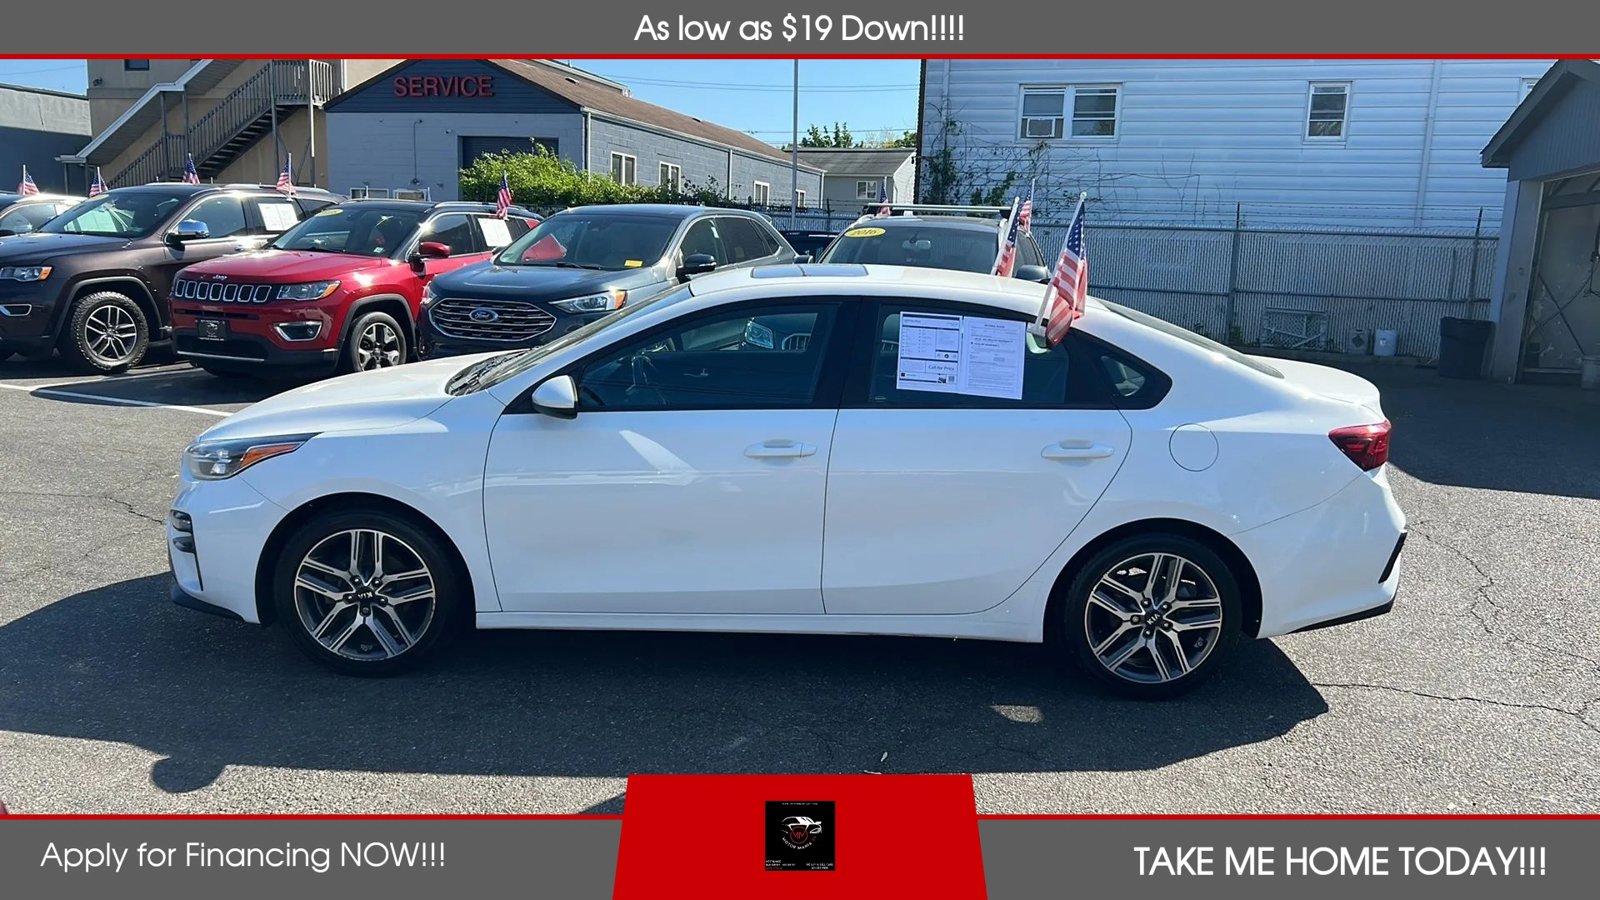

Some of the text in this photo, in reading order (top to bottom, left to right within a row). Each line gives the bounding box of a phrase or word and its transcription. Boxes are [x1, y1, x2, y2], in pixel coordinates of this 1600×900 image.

[393, 76, 493, 97] SERVICE
[358, 591, 373, 600] KIA
[1146, 614, 1160, 625] KIA
